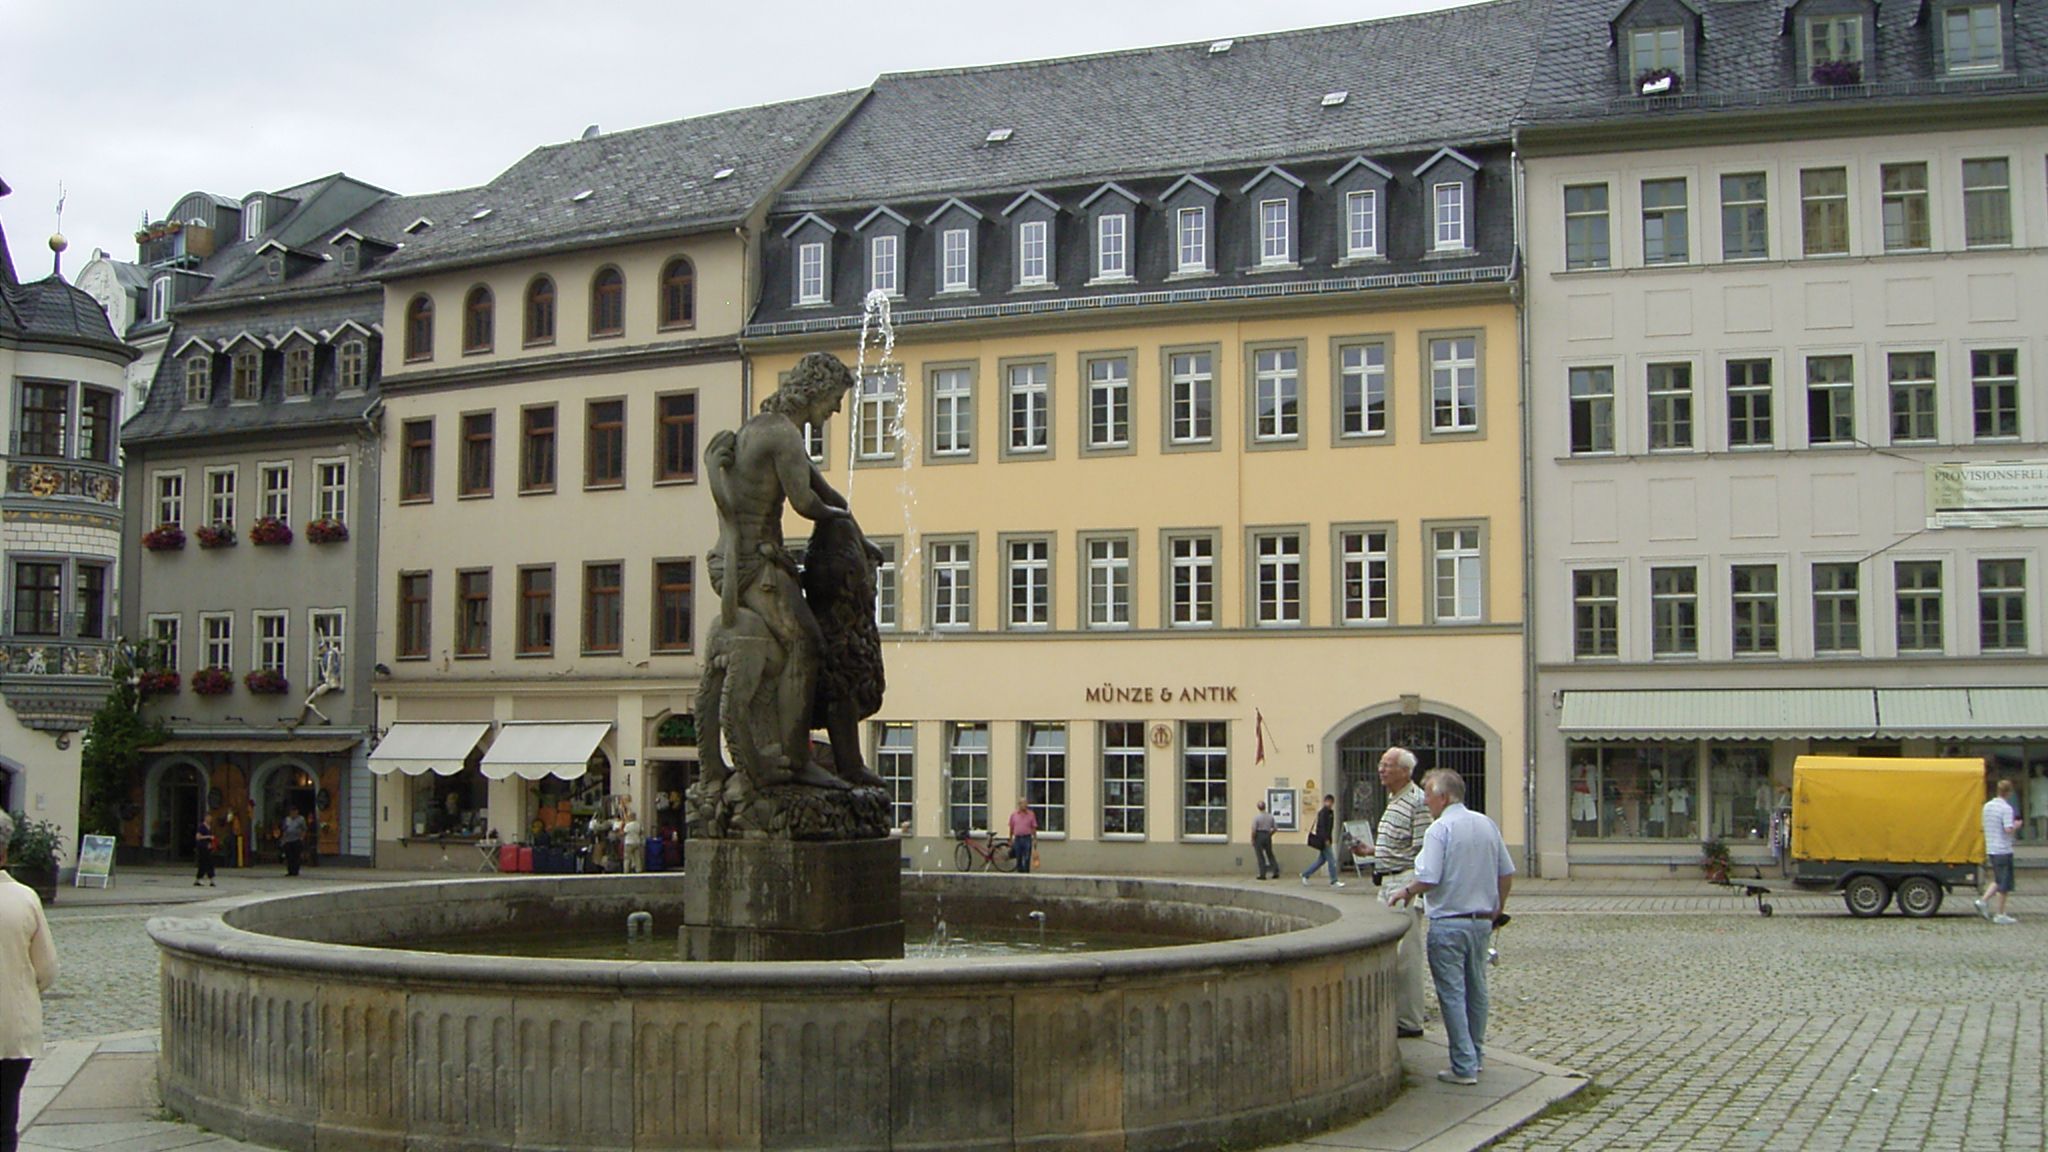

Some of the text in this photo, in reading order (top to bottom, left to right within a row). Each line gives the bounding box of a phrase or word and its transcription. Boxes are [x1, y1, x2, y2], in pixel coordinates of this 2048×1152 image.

[1086, 683, 1238, 703] MÜNZE & ANTIK
